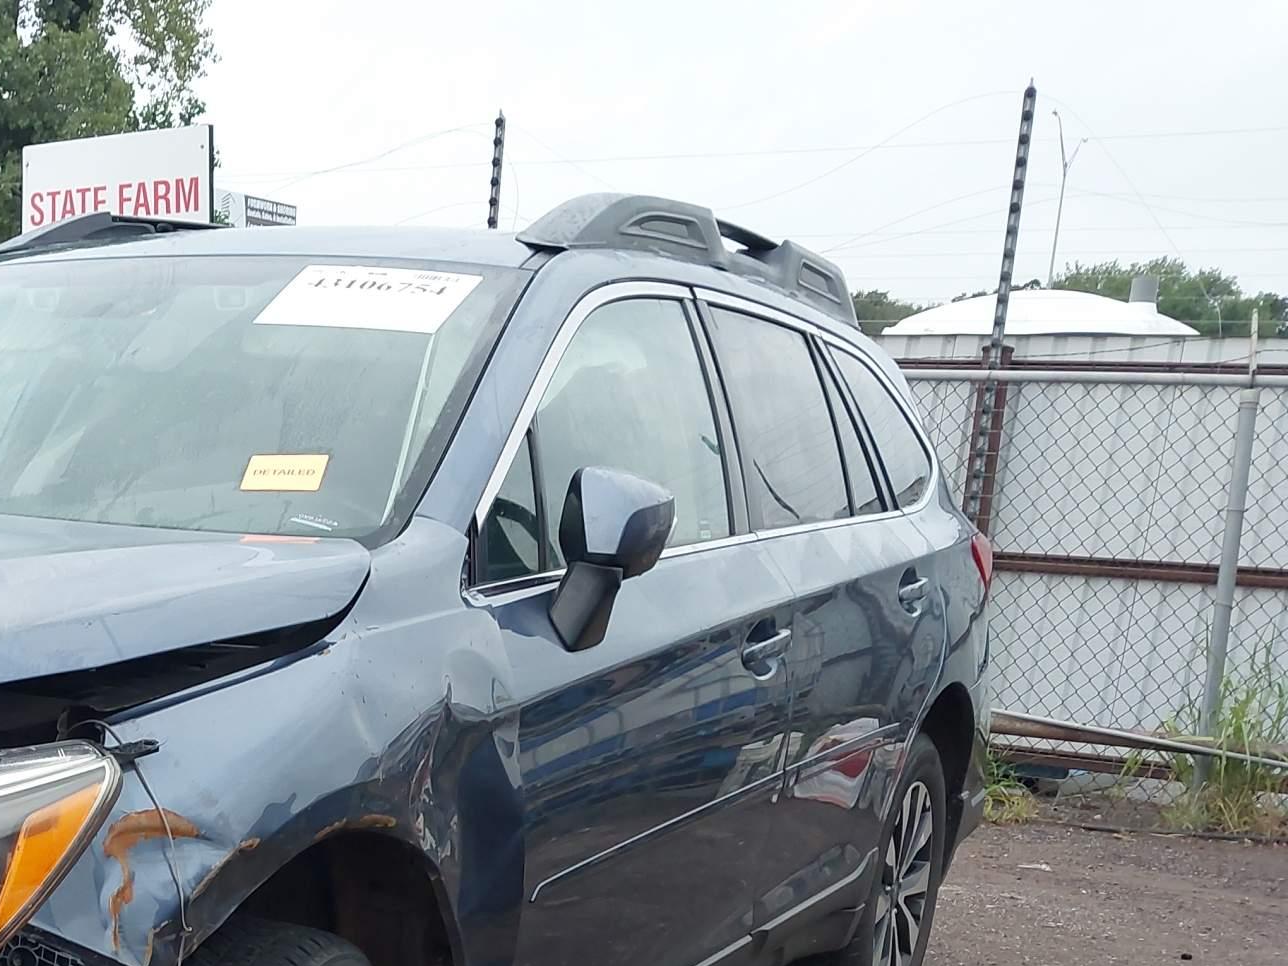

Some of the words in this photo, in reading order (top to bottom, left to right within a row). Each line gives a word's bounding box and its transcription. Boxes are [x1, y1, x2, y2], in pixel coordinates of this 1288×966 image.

[29, 185, 107, 227] STATE
[118, 175, 200, 217] FARM
[307, 277, 448, 296] 43106754
[252, 468, 317, 478] DETAILED
